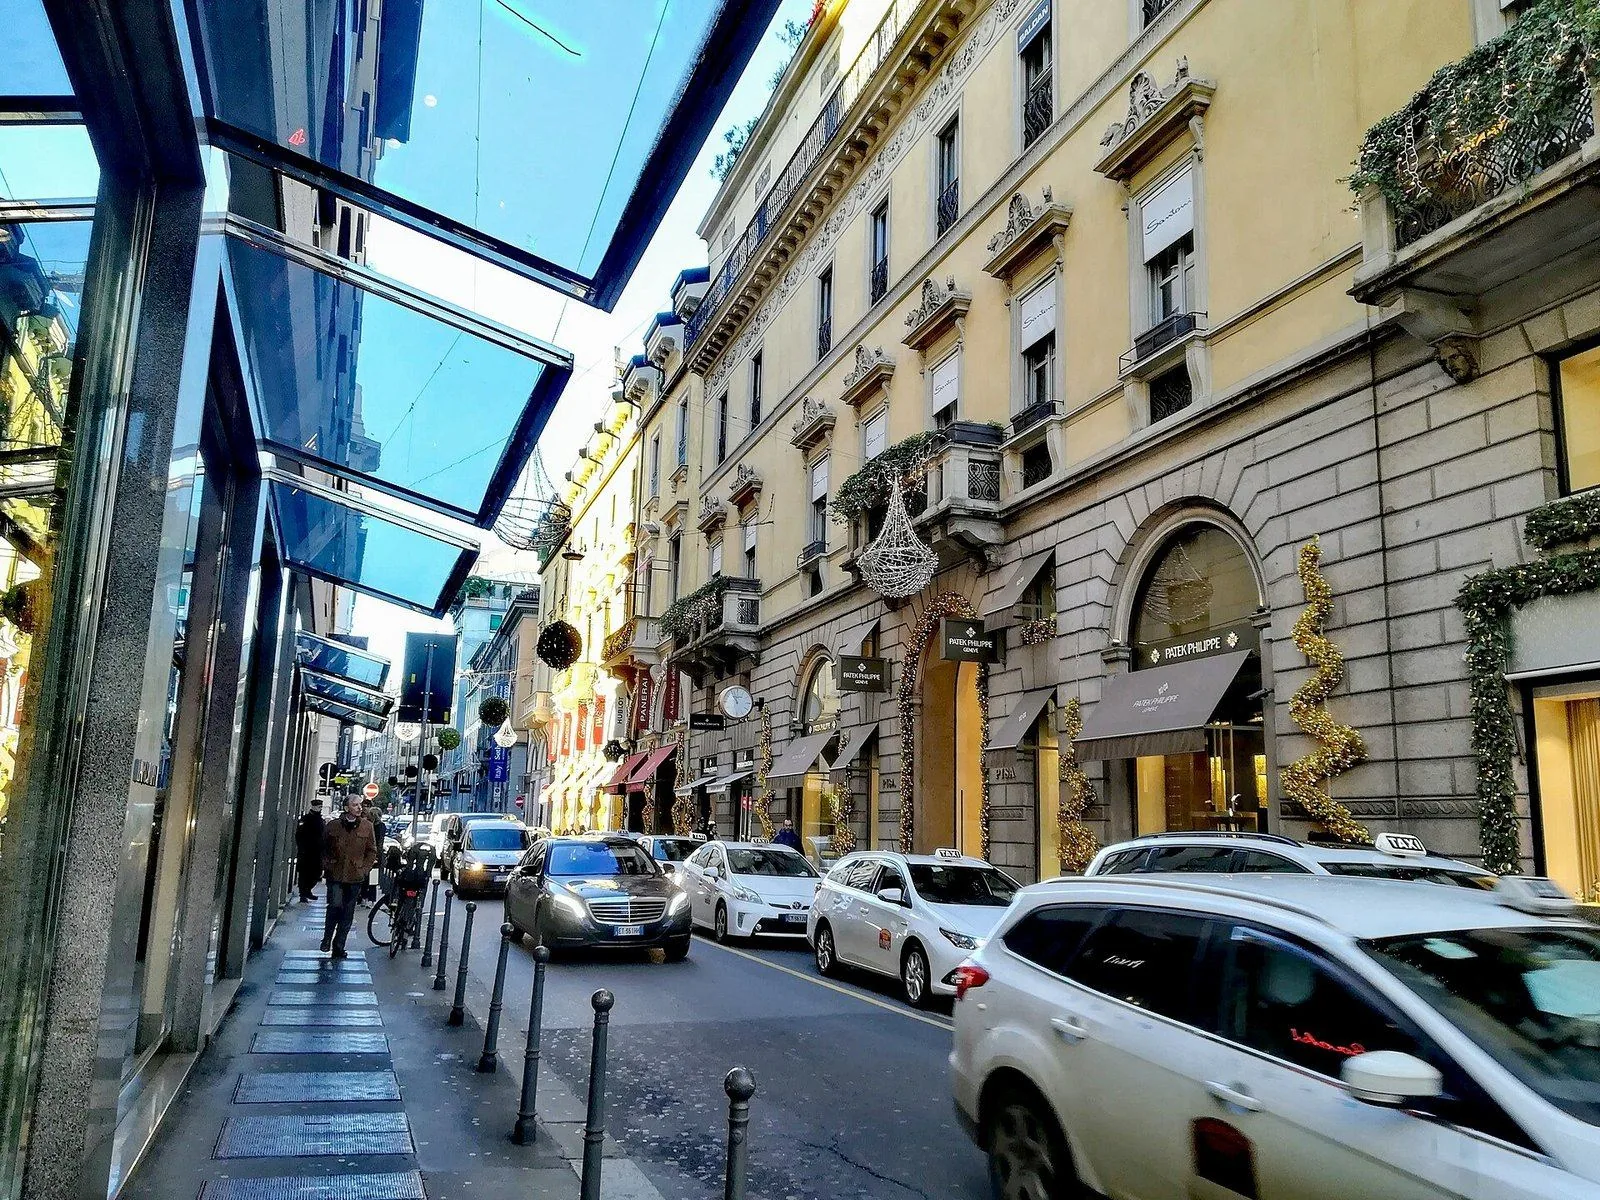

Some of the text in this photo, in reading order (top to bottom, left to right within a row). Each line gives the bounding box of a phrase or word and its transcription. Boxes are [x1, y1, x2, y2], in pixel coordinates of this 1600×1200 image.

[1145, 197, 1192, 235] Santoni
[949, 637, 993, 649] PATEK PHILIPPE
[1165, 637, 1221, 659] PATEK PHILIPPE
[858, 672, 881, 681] PHILIPPE
[640, 678, 648, 722] PANERAI
[995, 766, 1017, 780] PISA
[1387, 837, 1422, 850] TAXI
[940, 850, 961, 858] TAXI
